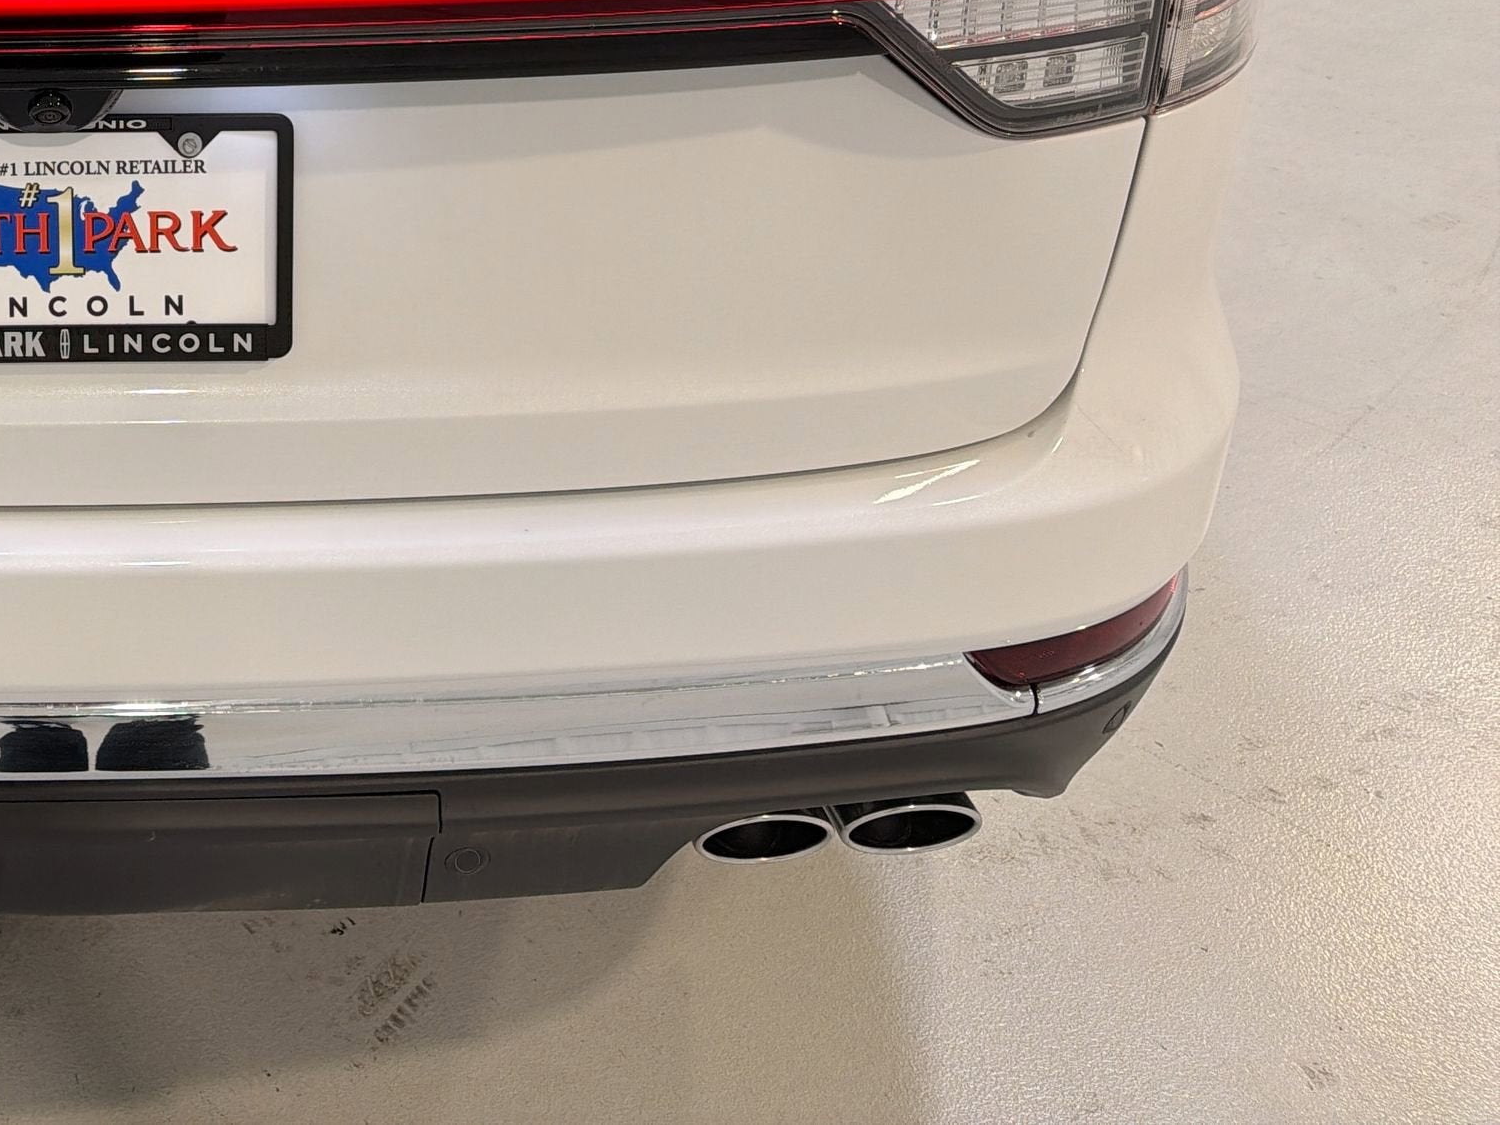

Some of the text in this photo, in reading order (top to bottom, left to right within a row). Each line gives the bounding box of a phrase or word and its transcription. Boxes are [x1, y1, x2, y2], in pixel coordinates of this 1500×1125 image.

[0, 160, 18, 177] #1
[23, 159, 112, 177] LINCOLN
[115, 158, 208, 176] RETAILER
[82, 209, 238, 254] PARK
[83, 331, 254, 355] LINCOLN
